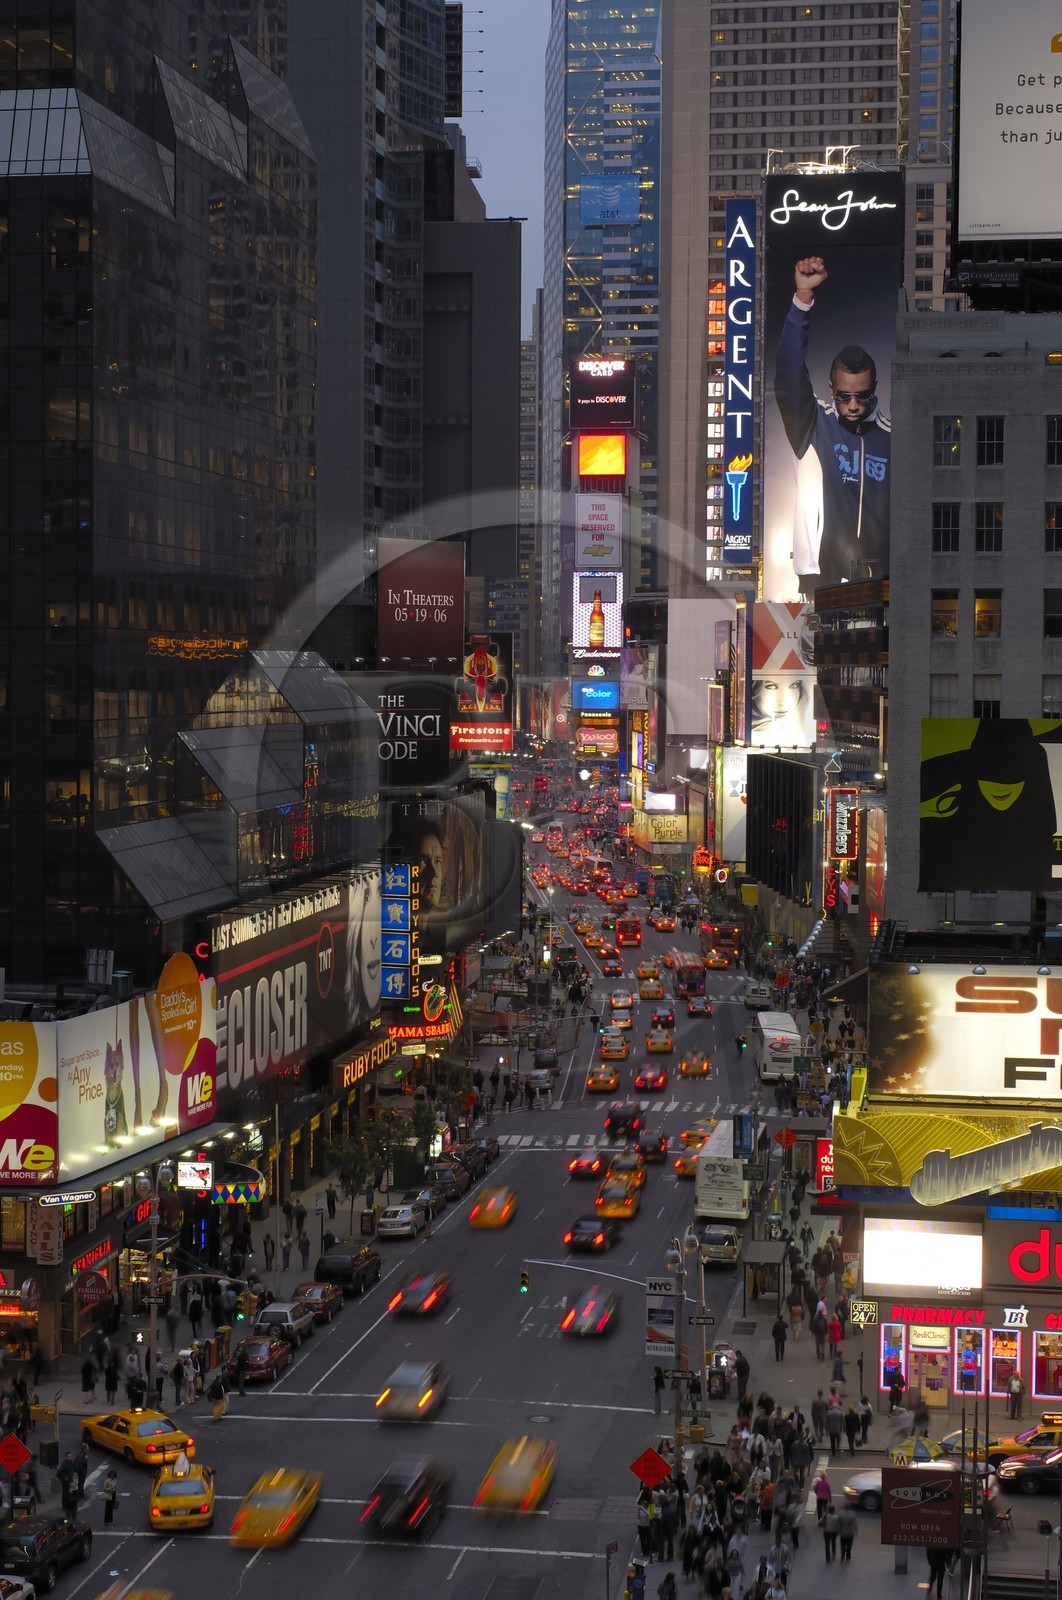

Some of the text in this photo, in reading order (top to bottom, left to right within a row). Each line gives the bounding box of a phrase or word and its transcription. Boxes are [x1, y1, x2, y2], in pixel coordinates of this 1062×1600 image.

[1017, 73, 1046, 87] Get
[995, 102, 1062, 115] Because
[1000, 130, 1038, 143] than
[600, 209, 621, 219] at&t
[822, 190, 897, 231] John
[726, 215, 755, 440] ARGENT
[579, 361, 626, 372] DISCOVER
[591, 369, 614, 377] CARD
[596, 396, 627, 404] DISCOVER
[591, 503, 606, 511] THIS
[588, 513, 609, 521] SPACE
[581, 524, 616, 532] RESERVED
[591, 533, 605, 541] FOR
[724, 534, 753, 544] ARGENT
[394, 607, 447, 623] 05 19 06
[573, 650, 621, 660] Budweiser
[585, 690, 612, 698] color
[378, 695, 405, 708] THE
[376, 713, 442, 737] VINCI
[450, 725, 511, 735] Firestone
[579, 732, 616, 742] YAHOO!
[401, 803, 445, 816] THE
[651, 818, 677, 829] Color
[654, 828, 683, 839] Purple
[211, 925, 231, 953] LAST
[318, 947, 332, 972] TNT
[161, 989, 186, 1009] Daddy's
[185, 997, 197, 1015] Girl
[228, 961, 308, 1090] CLOSER
[388, 1025, 424, 1037] MAMA
[60, 1055, 77, 1068] Sugar
[77, 1052, 86, 1062] and
[343, 1034, 397, 1088] RUBY FOO'S
[73, 1066, 91, 1085] Any
[1004, 1057, 1062, 1089] F
[78, 1083, 104, 1104] Price.
[187, 1071, 213, 1108] We
[197, 1104, 206, 1114] MORE
[11, 1171, 36, 1179] MORE
[44, 1192, 93, 1204] Van Wagner
[77, 1239, 112, 1273] FAMIGLIA
[77, 1287, 106, 1295] FAMIGLIA
[648, 1281, 672, 1292] NYC
[852, 1303, 876, 1313] OPEN
[852, 1311, 876, 1322] 24/7
[891, 1305, 987, 1326] PHARMACY
[912, 1329, 946, 1340] RediClinic
[895, 1489, 948, 1499] EQUINOX
[900, 1522, 941, 1532] NOW OPEN
[893, 1533, 949, 1544] 212.541.7000
